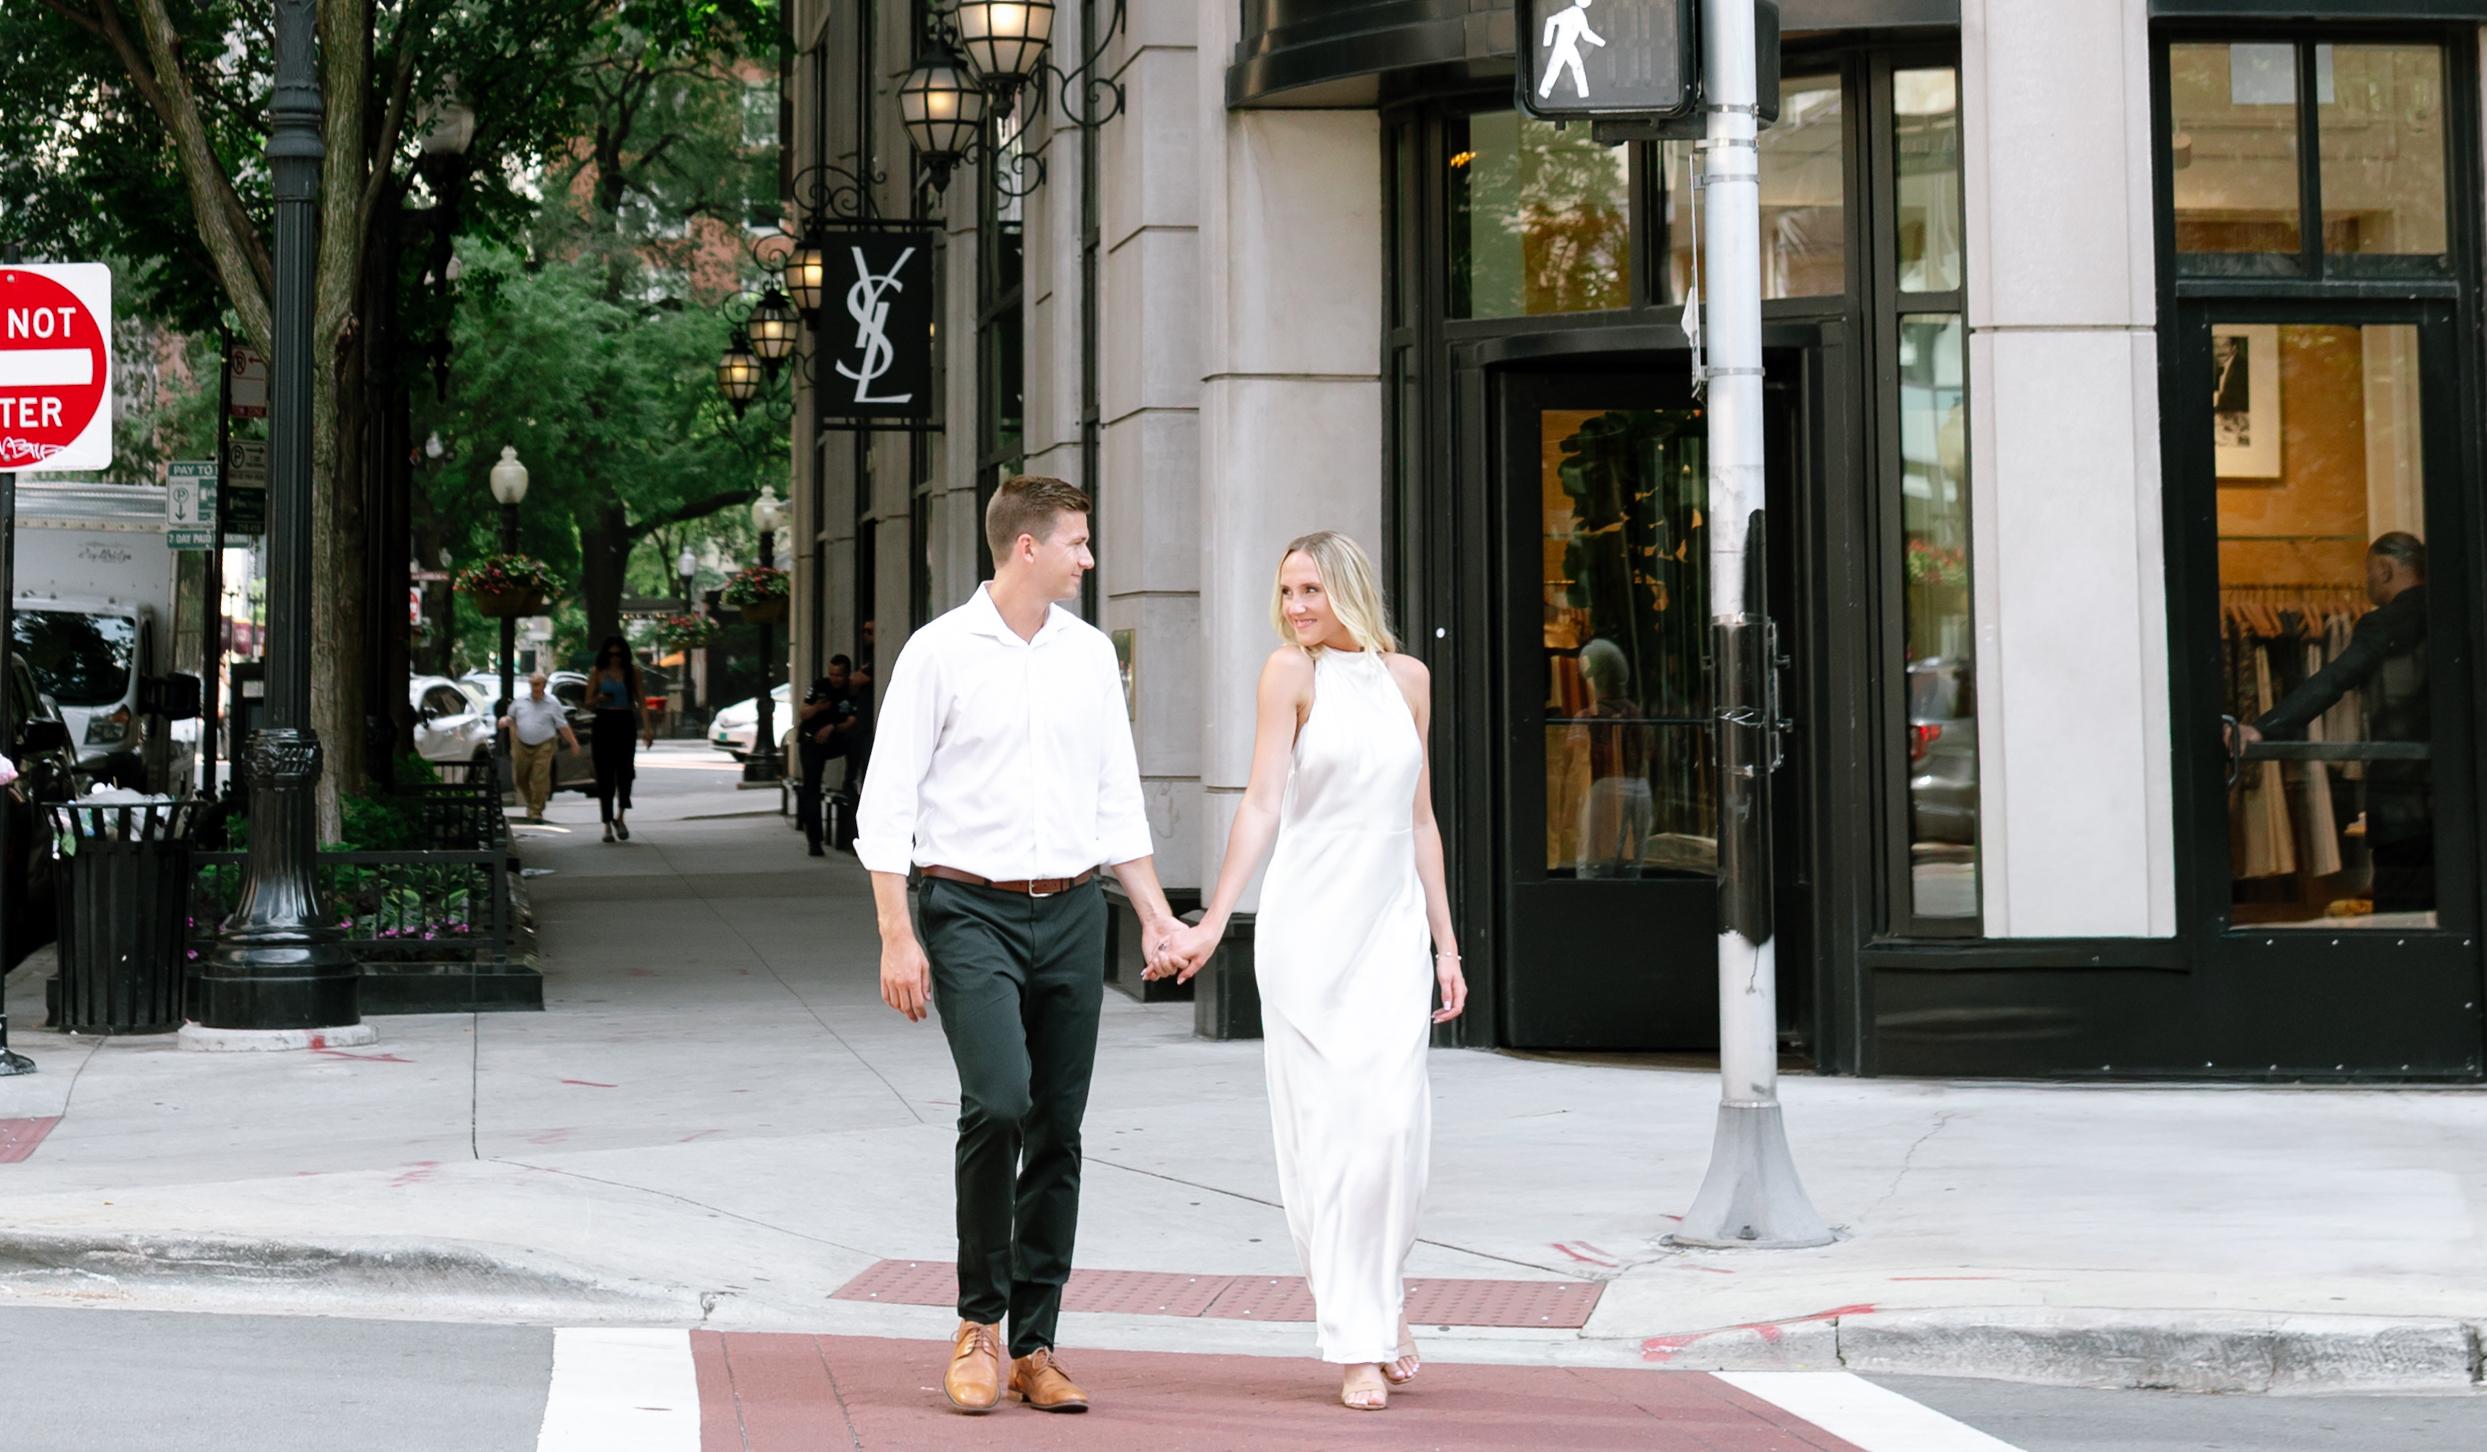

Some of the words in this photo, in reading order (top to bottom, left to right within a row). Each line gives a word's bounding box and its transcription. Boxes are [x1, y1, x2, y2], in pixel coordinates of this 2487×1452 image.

[7, 306, 76, 338] NOT
[835, 246, 916, 403] YSL
[0, 396, 63, 428] TER
[174, 465, 194, 475] PAY
[197, 464, 213, 475] TO
